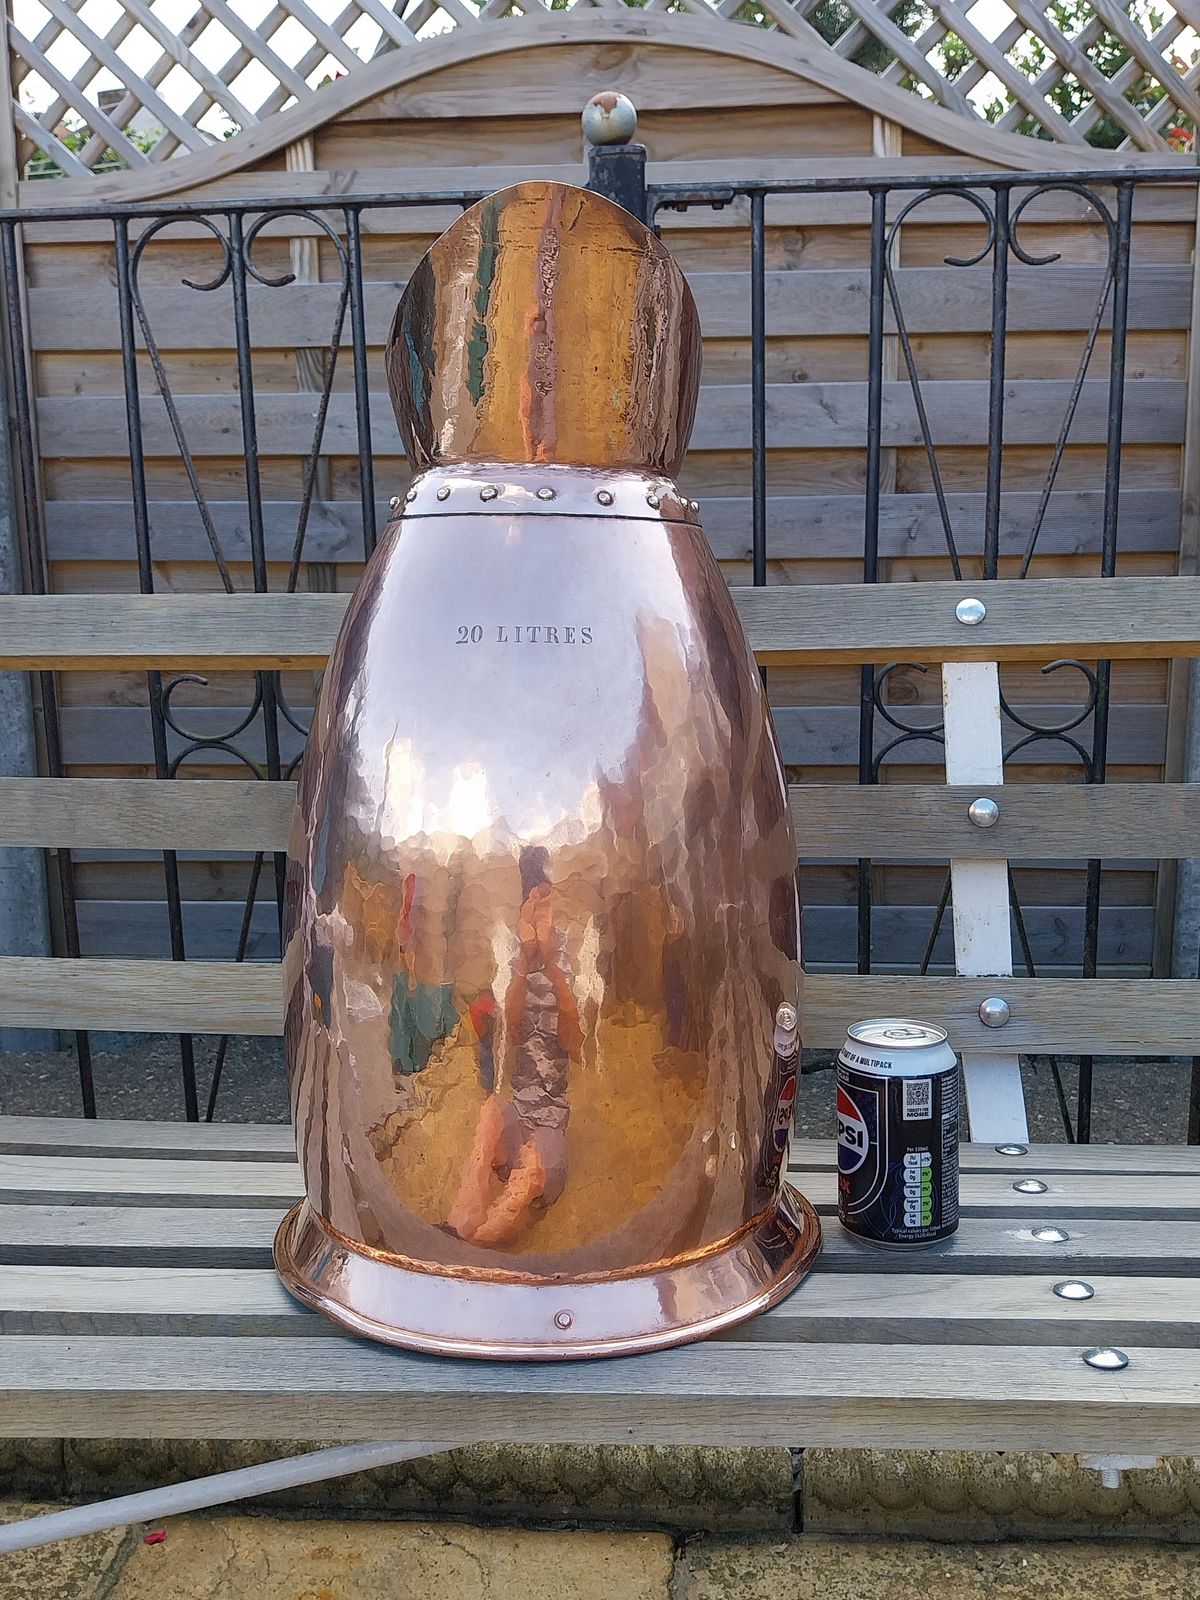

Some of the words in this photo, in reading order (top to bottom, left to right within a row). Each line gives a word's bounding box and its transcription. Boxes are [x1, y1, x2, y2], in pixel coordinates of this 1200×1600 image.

[455, 624, 483, 644] 20
[496, 625, 593, 645] LITRES
[860, 1057, 892, 1069] MULTIPACK
